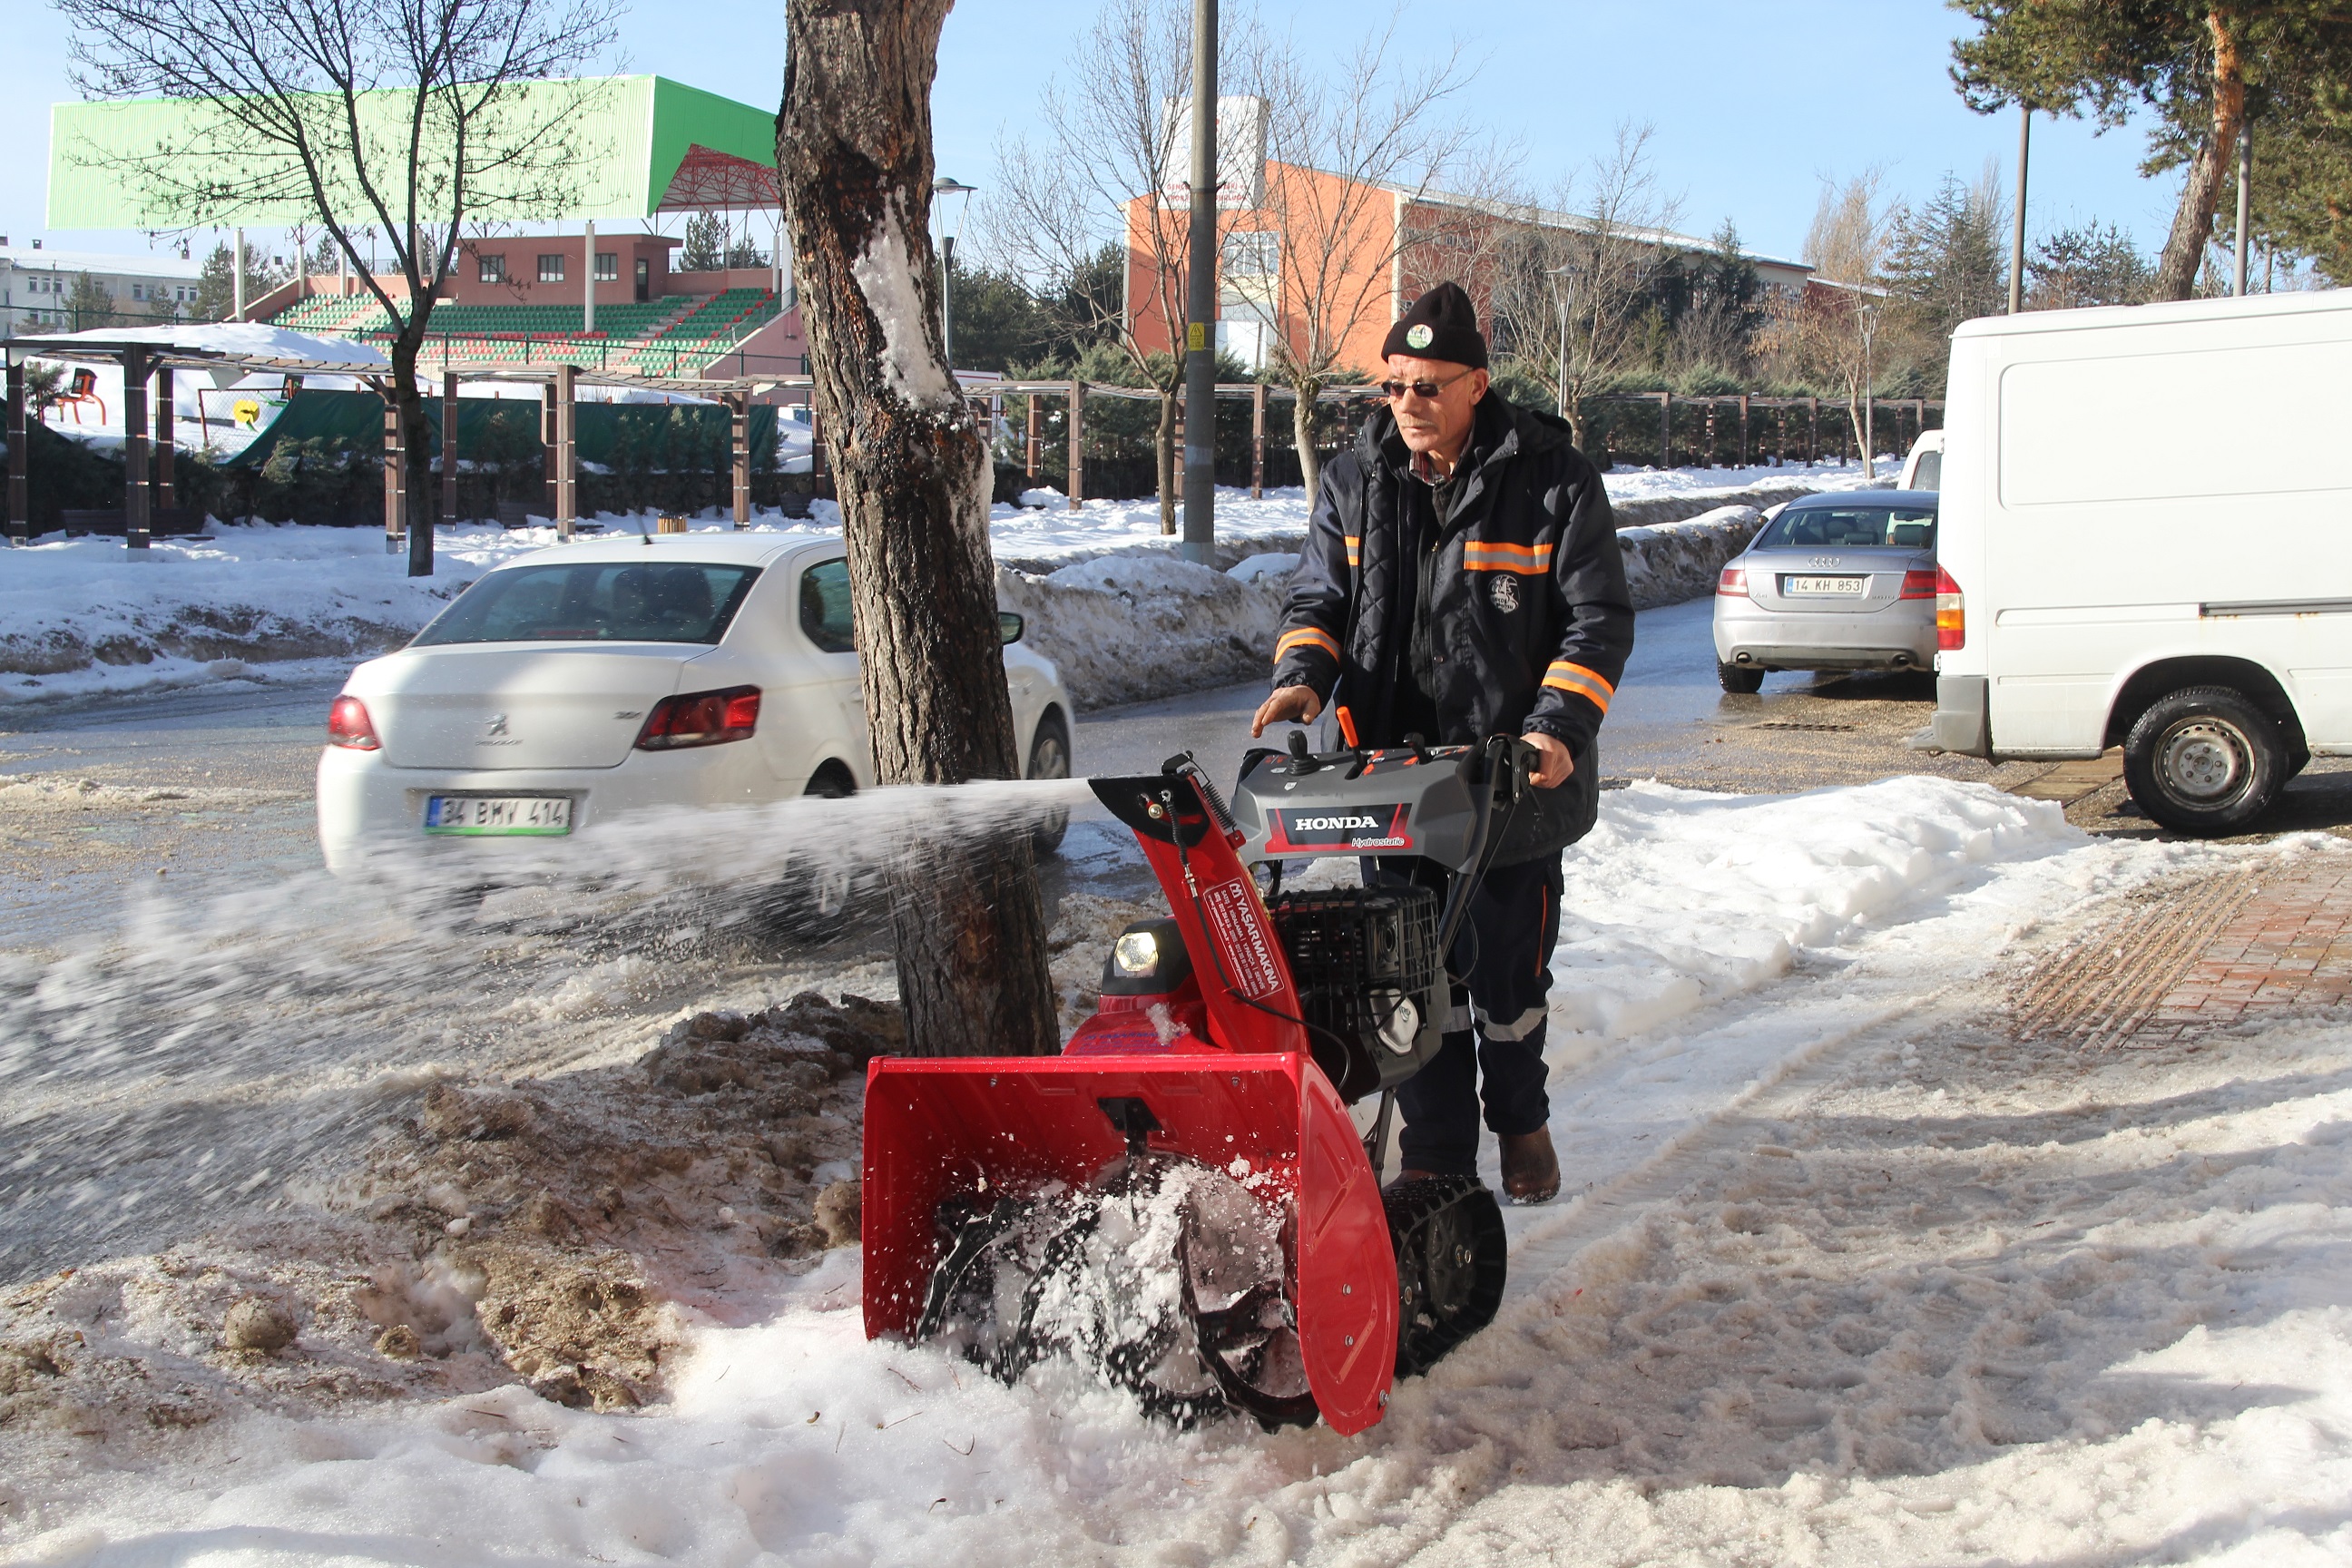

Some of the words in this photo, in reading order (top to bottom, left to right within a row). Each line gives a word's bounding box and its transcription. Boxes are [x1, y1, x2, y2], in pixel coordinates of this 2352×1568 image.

[1796, 580, 1808, 591] 14
[1815, 580, 1830, 591] KH
[1838, 580, 1860, 592] 853
[442, 799, 466, 825] 34
[528, 800, 564, 826] 414
[1295, 816, 1379, 831] HONDA
[1351, 837, 1405, 848] Hydrostatic
